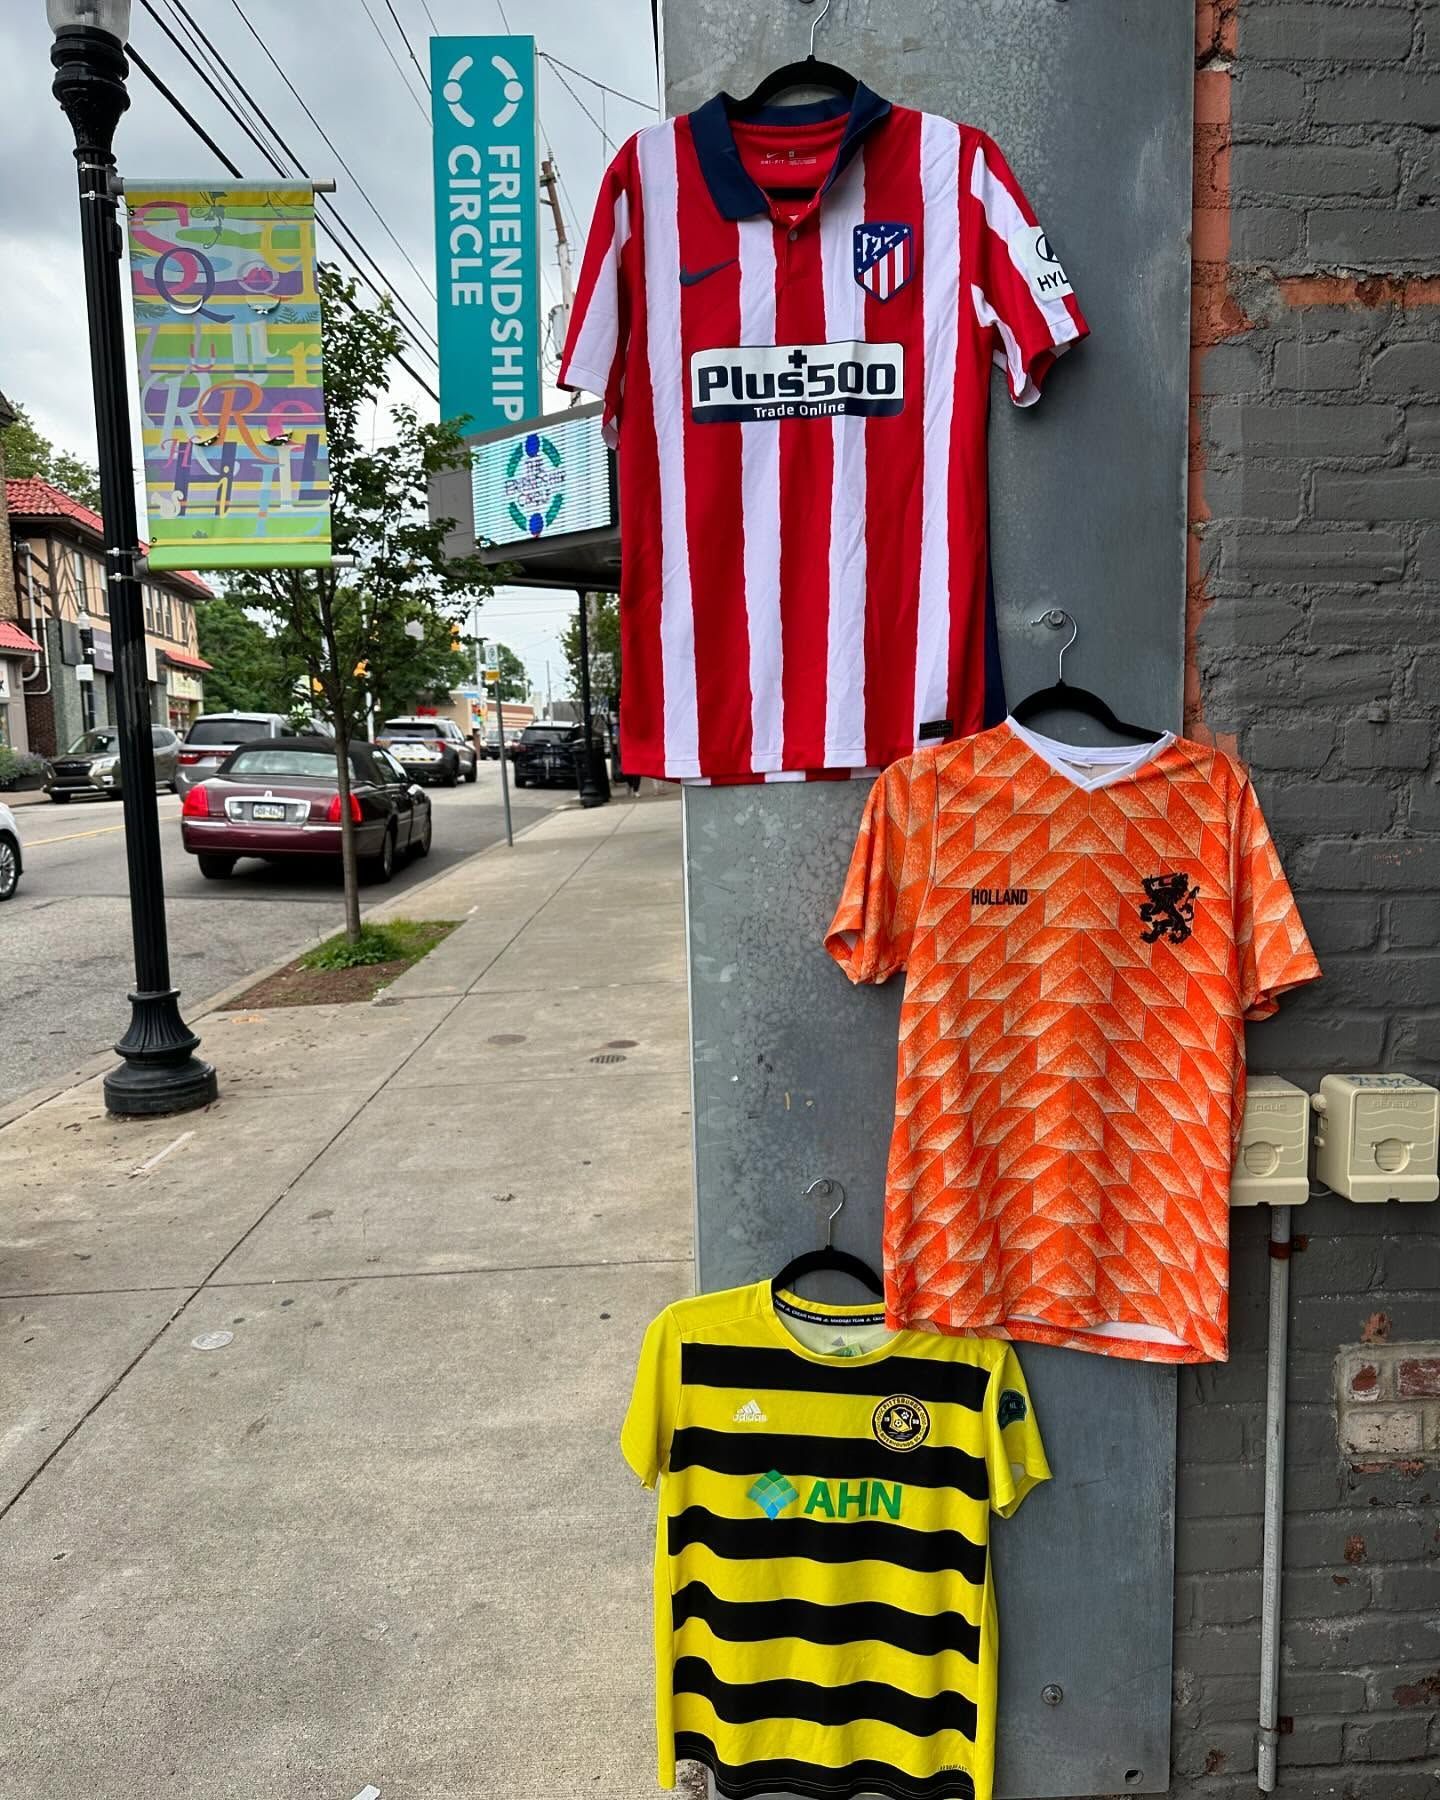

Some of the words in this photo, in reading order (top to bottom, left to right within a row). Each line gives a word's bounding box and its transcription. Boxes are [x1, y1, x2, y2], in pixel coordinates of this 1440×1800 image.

[448, 144, 483, 306] CIRCLE
[488, 145, 524, 422] FRIENDSHIP
[698, 360, 896, 402] Plus500
[754, 405, 795, 419] Trade
[799, 402, 846, 417] Online
[971, 888, 1028, 906] HOLLAND
[803, 1480, 903, 1520] AHN
